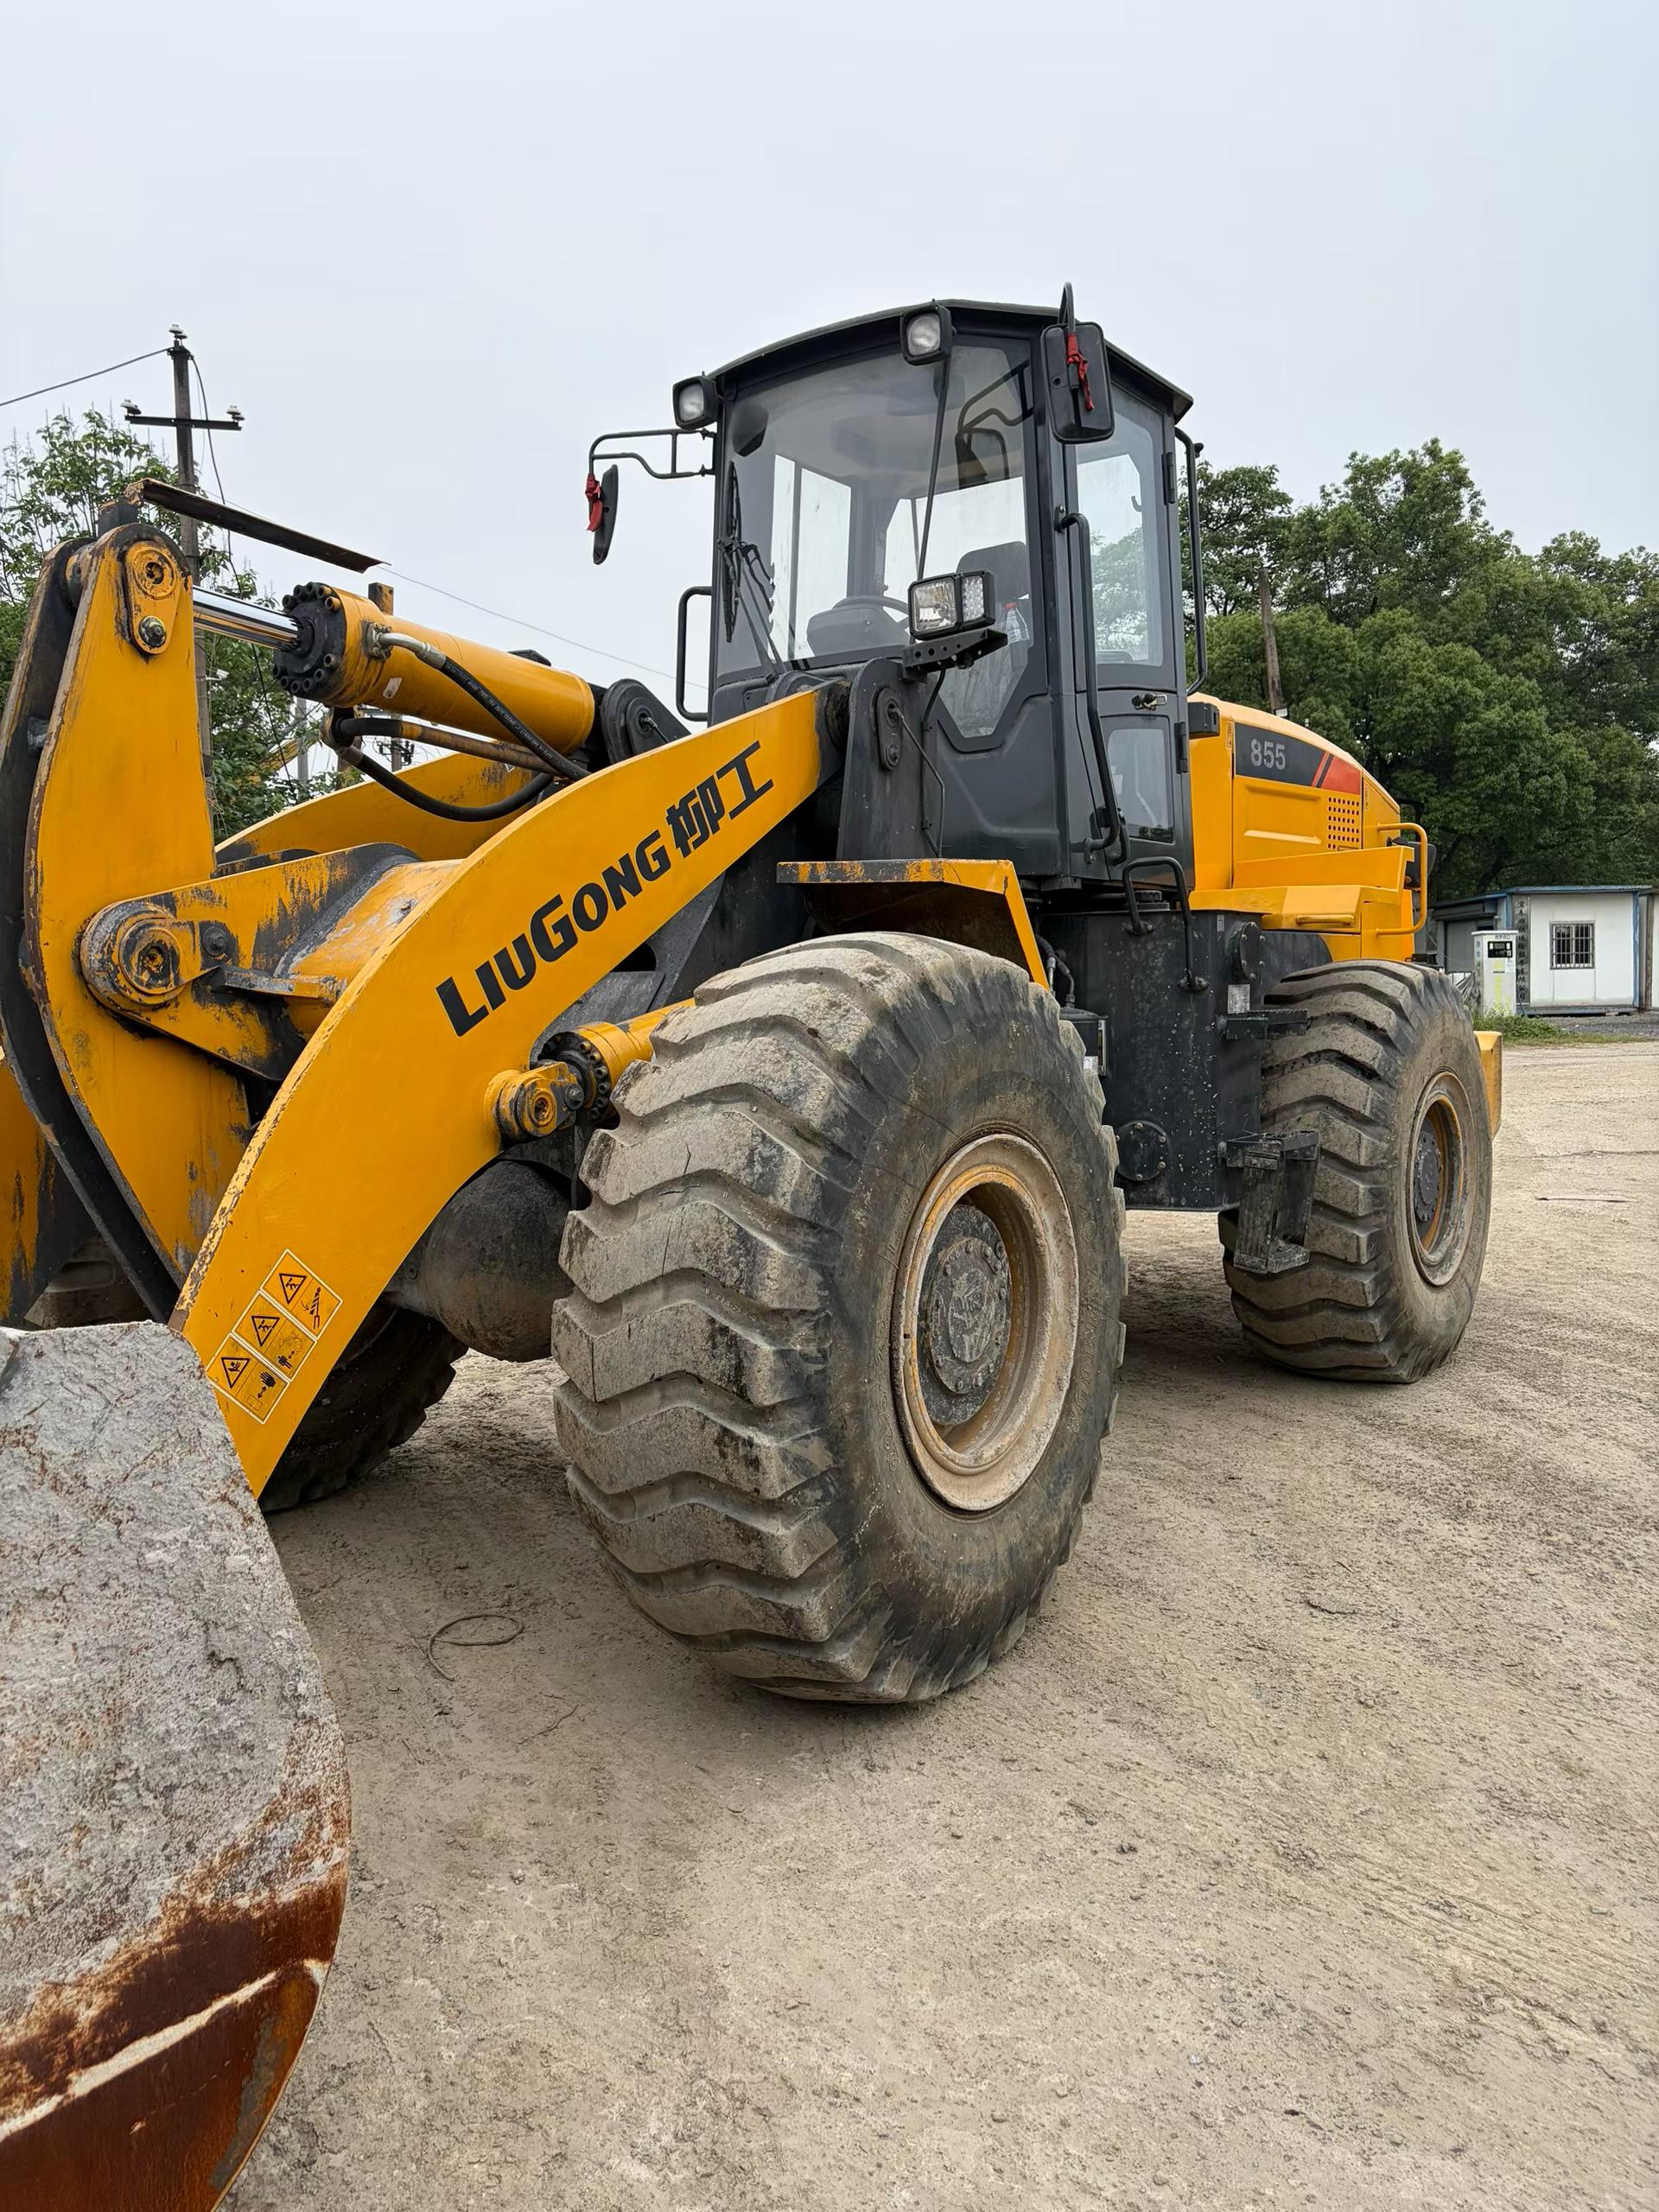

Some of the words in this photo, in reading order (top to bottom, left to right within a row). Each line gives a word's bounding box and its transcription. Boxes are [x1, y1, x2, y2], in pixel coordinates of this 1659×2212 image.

[1250, 739, 1286, 771] 855
[435, 830, 671, 1037] LIUGONG
[665, 740, 774, 858] 柳工
